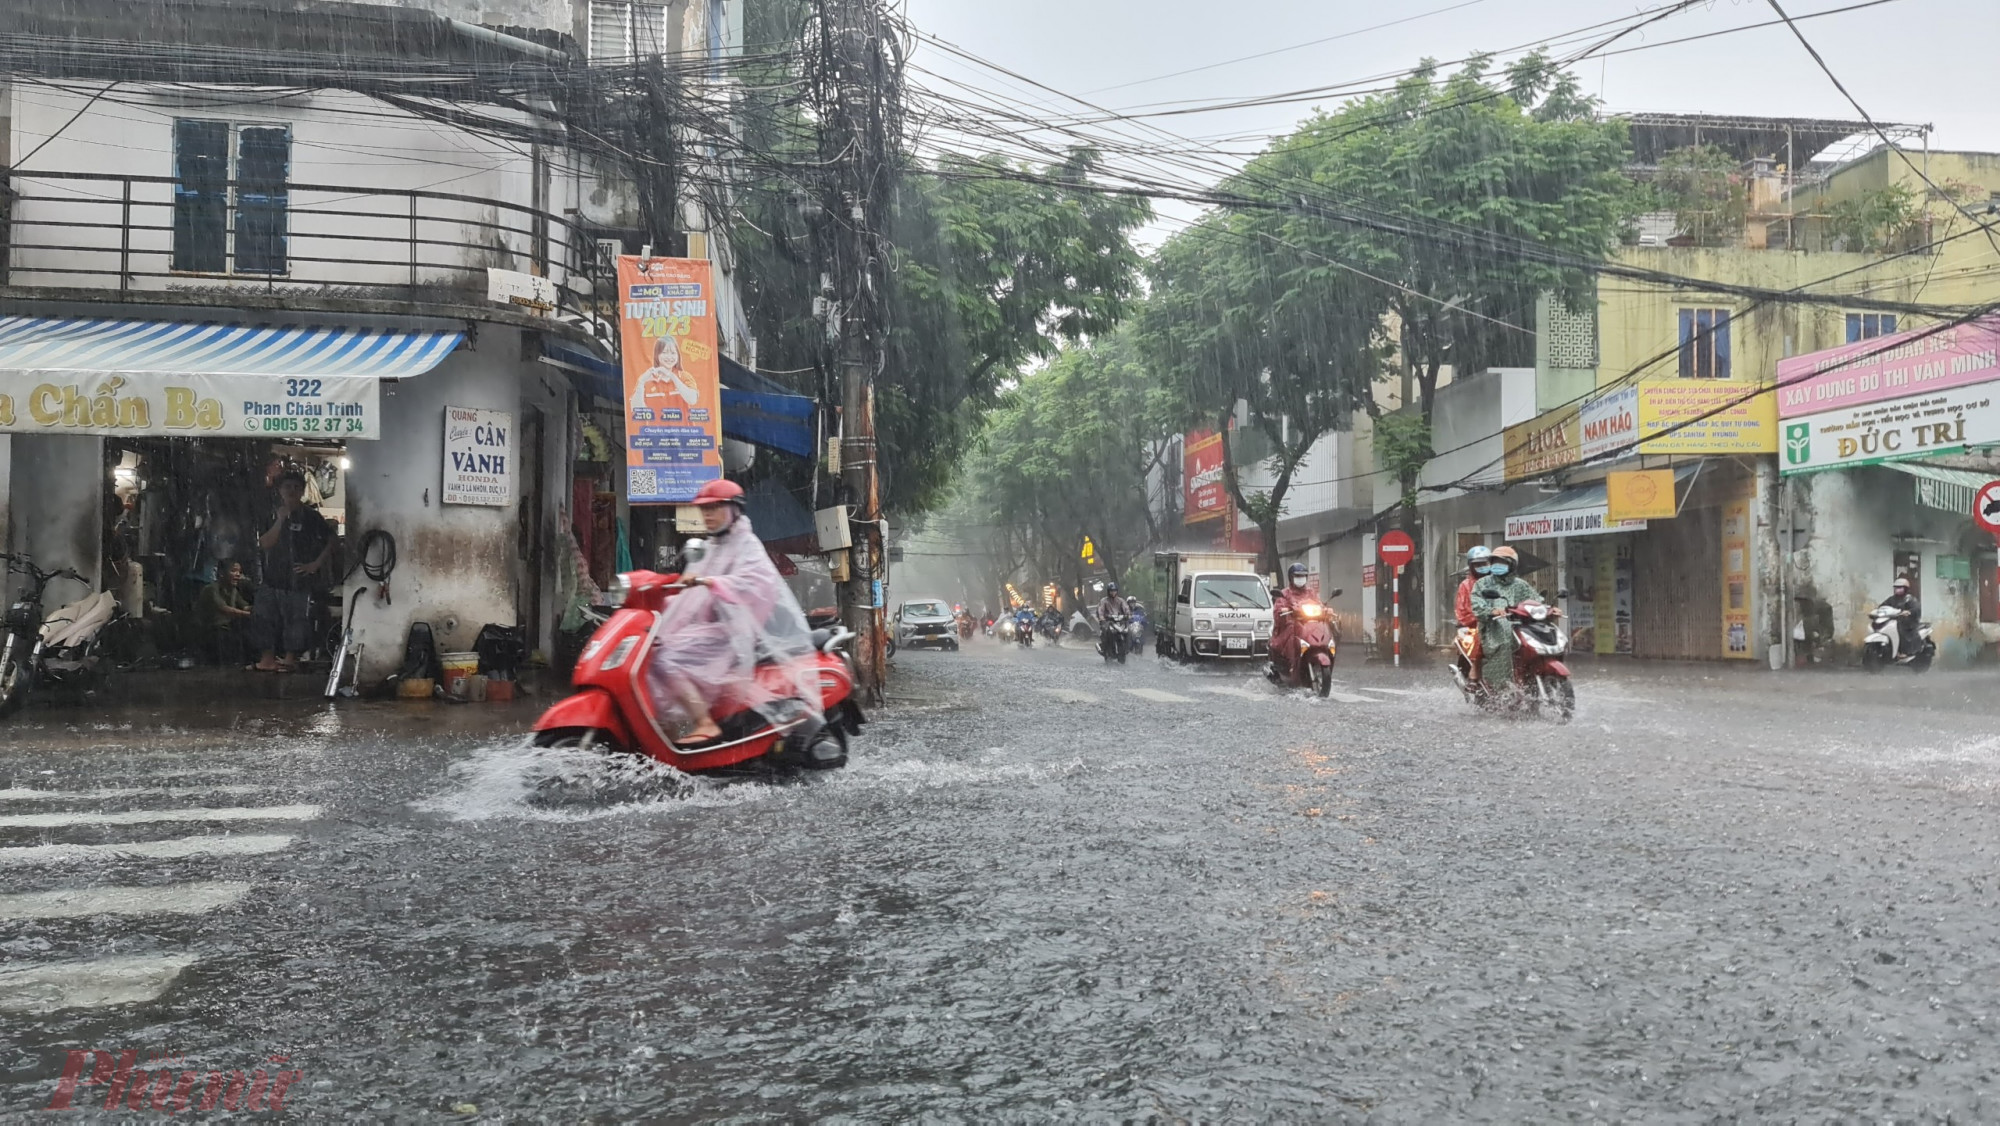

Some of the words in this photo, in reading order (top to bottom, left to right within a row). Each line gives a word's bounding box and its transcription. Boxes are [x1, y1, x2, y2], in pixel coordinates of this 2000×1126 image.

[672, 300, 707, 318] SINH
[642, 316, 691, 338] 2023
[1930, 329, 1957, 353] KẾT
[286, 378, 322, 397] 322
[1786, 385, 1812, 406] XÂY
[1816, 378, 1856, 402] DỰNG
[1860, 371, 1880, 393] ĐÔ
[1883, 367, 1909, 388] THỊ
[1913, 358, 1946, 382] VĂN
[1951, 349, 1997, 376] MINH
[29, 376, 151, 427] Chấn
[163, 386, 225, 429] Ba
[244, 401, 280, 416] Phan
[286, 401, 322, 416] Châu
[1862, 419, 1876, 427] NON
[1894, 413, 1910, 422] HỌC
[1947, 404, 1963, 413] HỌC
[1966, 401, 1977, 410] CƠ
[1980, 398, 1990, 407] SỞ
[263, 418, 298, 432] 0905
[302, 418, 320, 432] 32
[324, 418, 341, 432] 37
[346, 418, 363, 432] 34
[452, 410, 477, 422] QUANG
[1584, 418, 1608, 442] NAM
[1610, 406, 1632, 434] HẢO
[475, 421, 506, 447] CÂN
[1838, 426, 1901, 458] ĐỨC
[1912, 412, 1967, 447] TRÍ
[452, 447, 505, 474] VÀNH
[458, 475, 498, 483] HONDA
[1508, 518, 1524, 536] XUÂN
